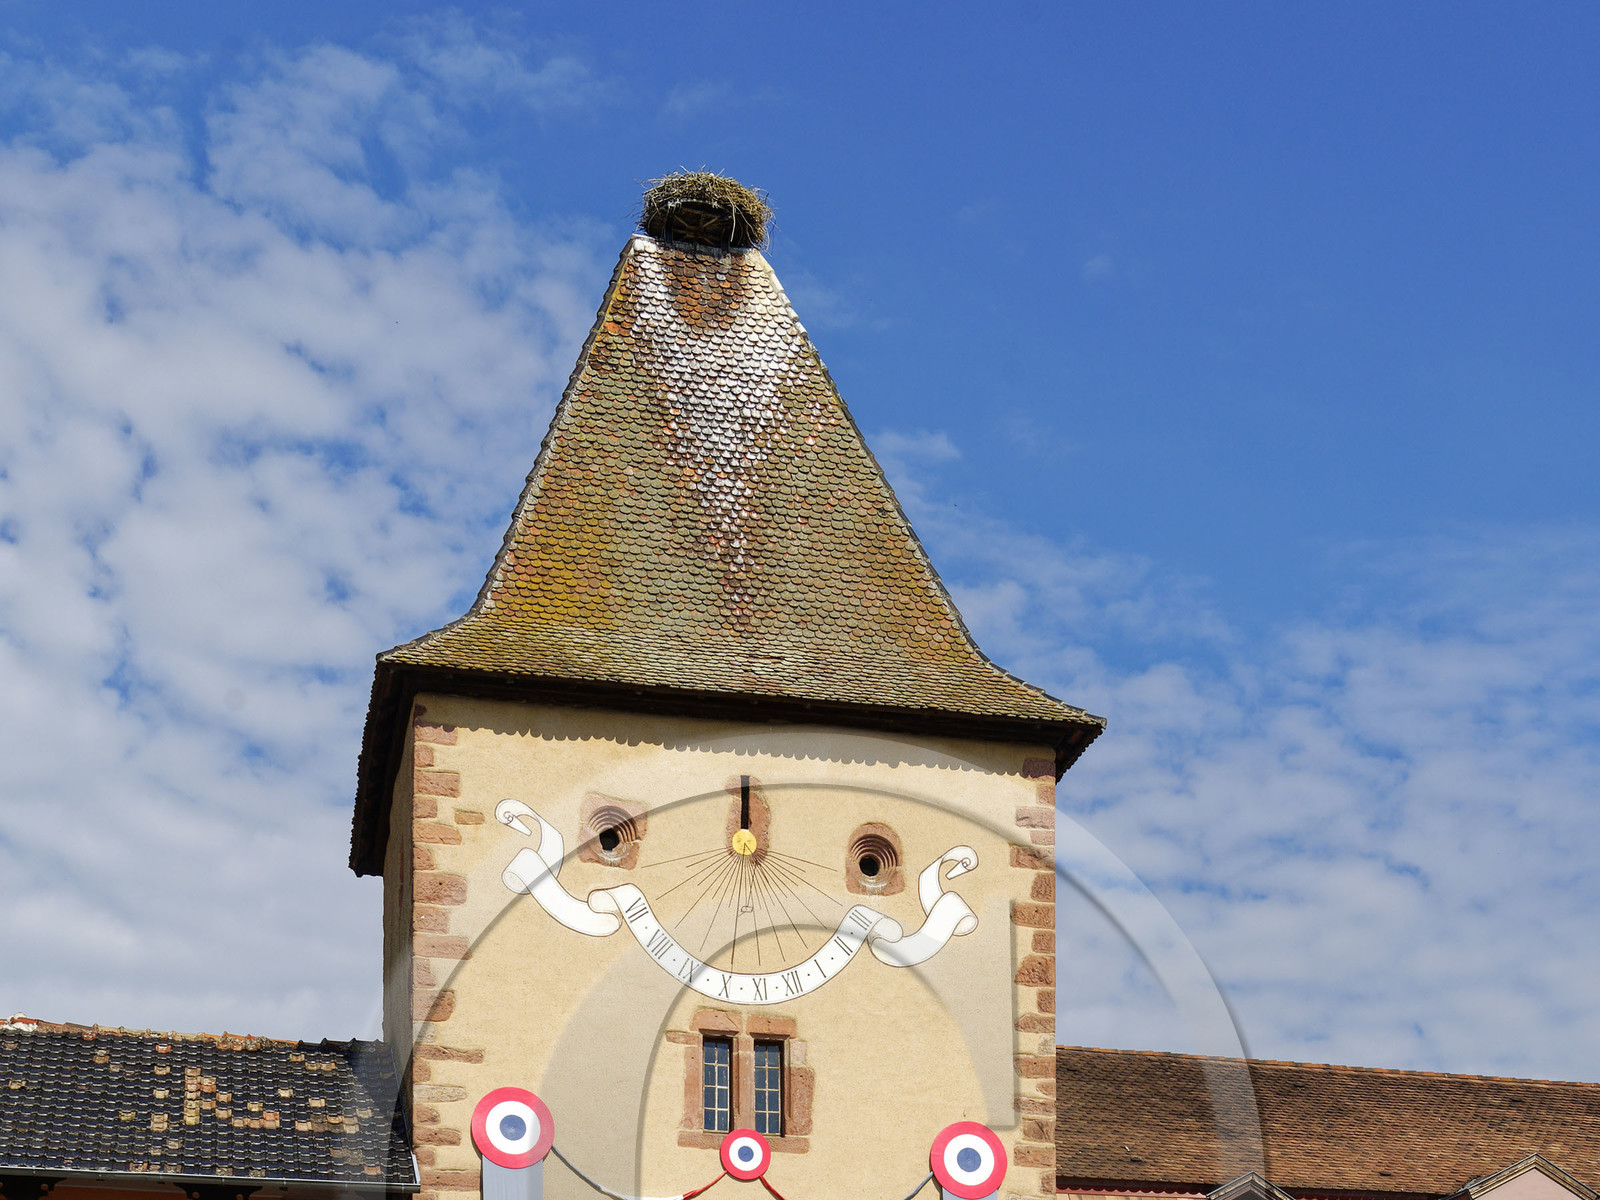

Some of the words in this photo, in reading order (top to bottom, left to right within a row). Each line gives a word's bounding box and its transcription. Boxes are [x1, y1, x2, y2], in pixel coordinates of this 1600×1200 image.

[625, 897, 649, 924] VII
[646, 929, 674, 960] VIII
[678, 957, 700, 983] IX
[718, 973, 733, 999] X
[752, 977, 768, 1001] XI
[781, 970, 804, 997] XII
[814, 959, 827, 979] I
[833, 936, 854, 957] II
[849, 909, 873, 931] III
